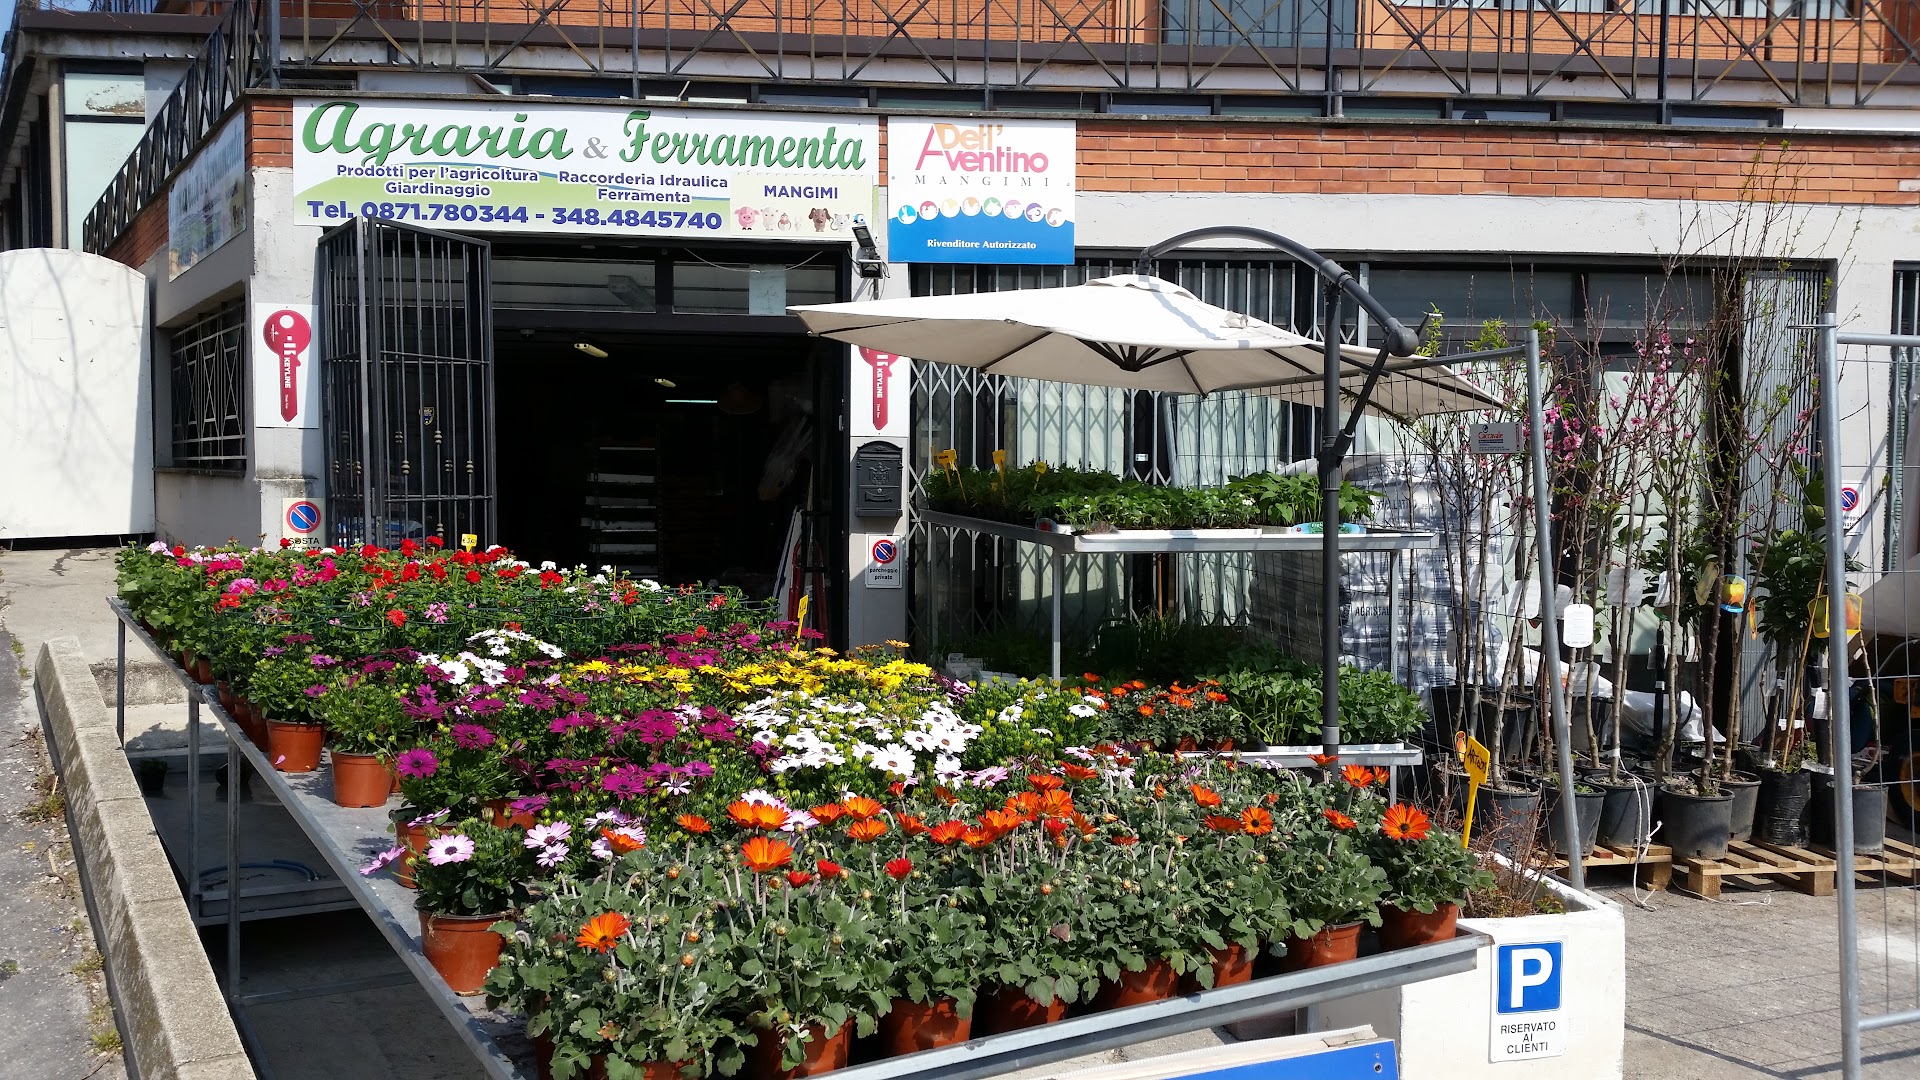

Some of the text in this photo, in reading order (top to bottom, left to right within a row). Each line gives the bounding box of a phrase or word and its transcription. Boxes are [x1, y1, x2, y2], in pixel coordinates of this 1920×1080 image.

[302, 101, 866, 170] Agraria & Ferramenta
[934, 123, 1003, 150] Dell'
[915, 124, 1049, 173] Aventino
[337, 164, 538, 183] Prodotti per l'agricoltura
[558, 170, 728, 188] Raccorderia Idraulica
[915, 174, 1049, 187] MANGIMI
[385, 181, 491, 198] Giardinaggio
[598, 188, 691, 203] Ferramenta
[763, 185, 838, 200] MANGIMI
[307, 200, 354, 219] Tel.
[360, 202, 529, 224] 0871.780344
[551, 207, 722, 230] 348.4845740
[927, 239, 1037, 250] Rivenditore Autorizzato
[283, 357, 292, 389] KEYLINE
[1511, 948, 1553, 1008] P
[1501, 1021, 1556, 1034] RISERVATO
[1522, 1033, 1533, 1043] AI
[1507, 1042, 1548, 1054] CLIENTI
